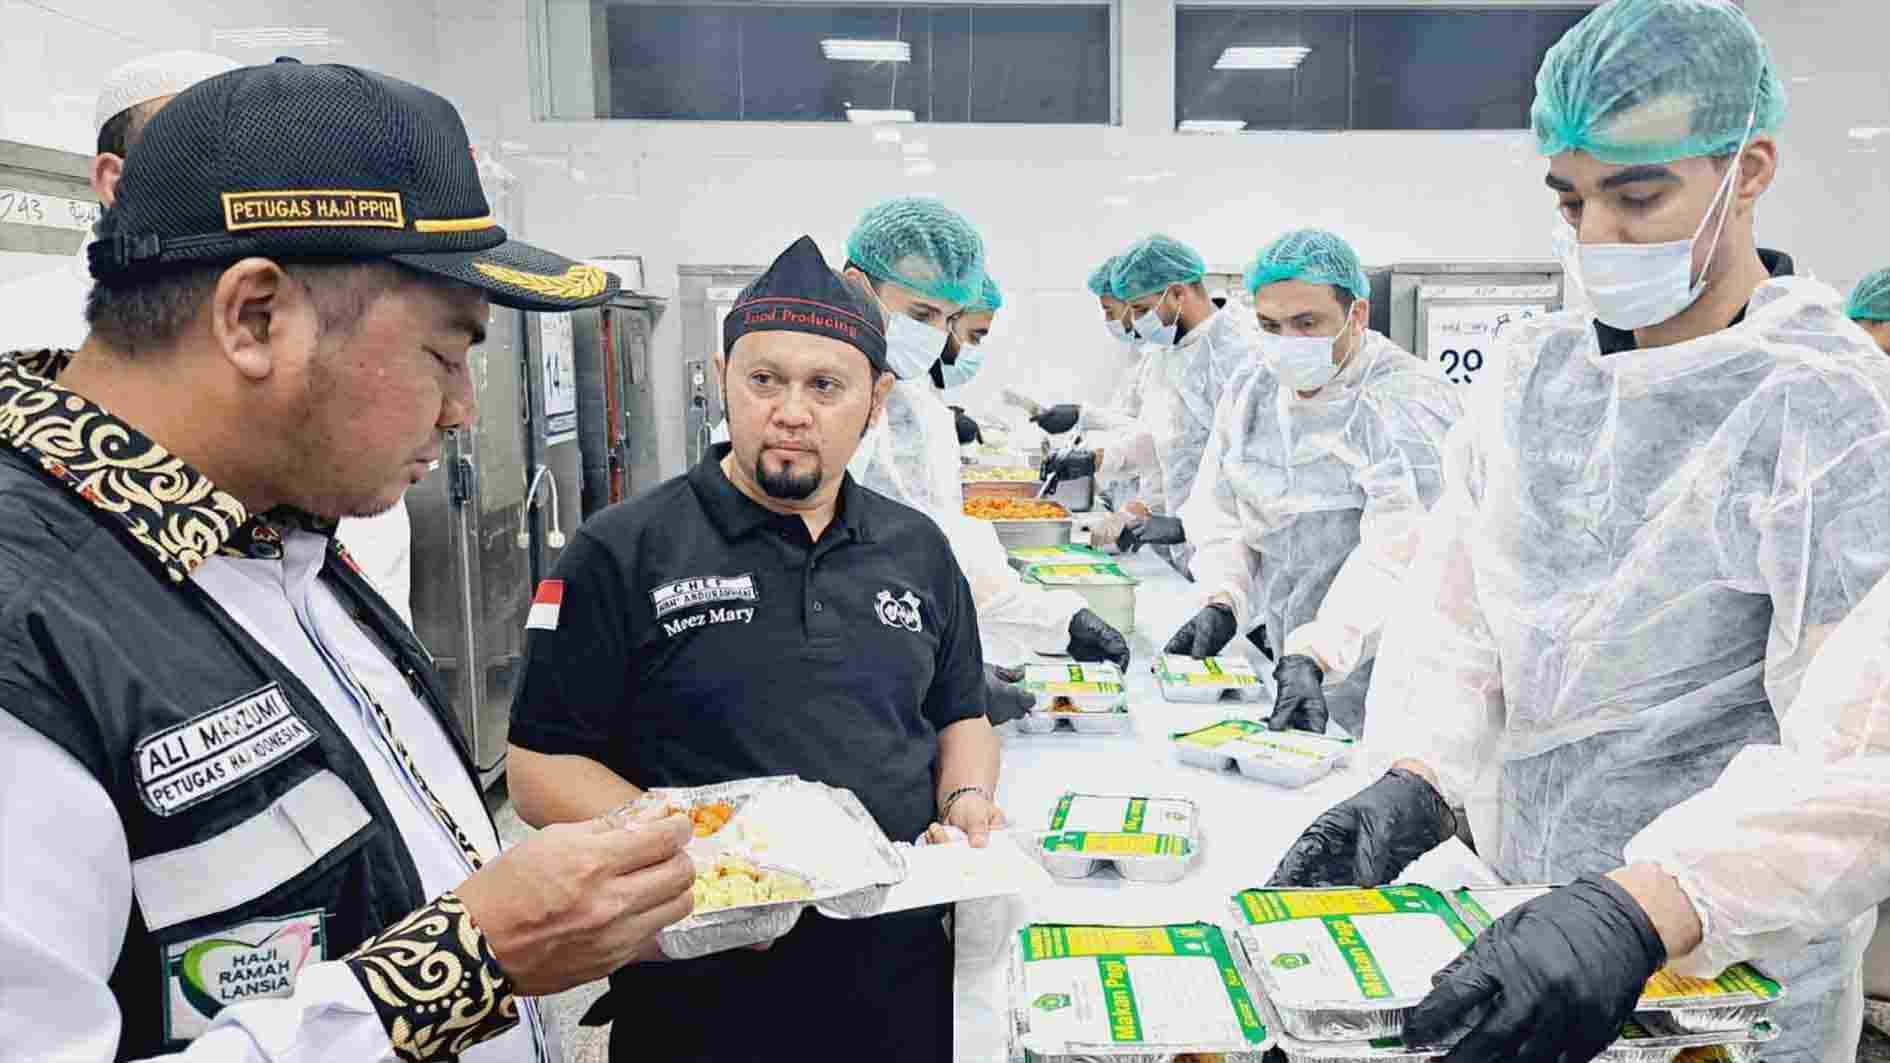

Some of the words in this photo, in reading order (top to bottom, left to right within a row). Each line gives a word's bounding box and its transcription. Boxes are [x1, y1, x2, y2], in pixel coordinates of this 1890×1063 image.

[233, 200, 312, 220] PETUGAS
[316, 199, 355, 218] HAJI
[358, 200, 397, 219] PPIH
[708, 607, 755, 624] Mary
[150, 736, 190, 775] ALI
[152, 761, 227, 803] PETUGAS
[233, 948, 277, 968] HAJI
[219, 960, 290, 984] RAMAH
[1103, 960, 1129, 989] Pagi
[221, 977, 290, 1000] LANSIA
[1112, 988, 1138, 1040] Makan
